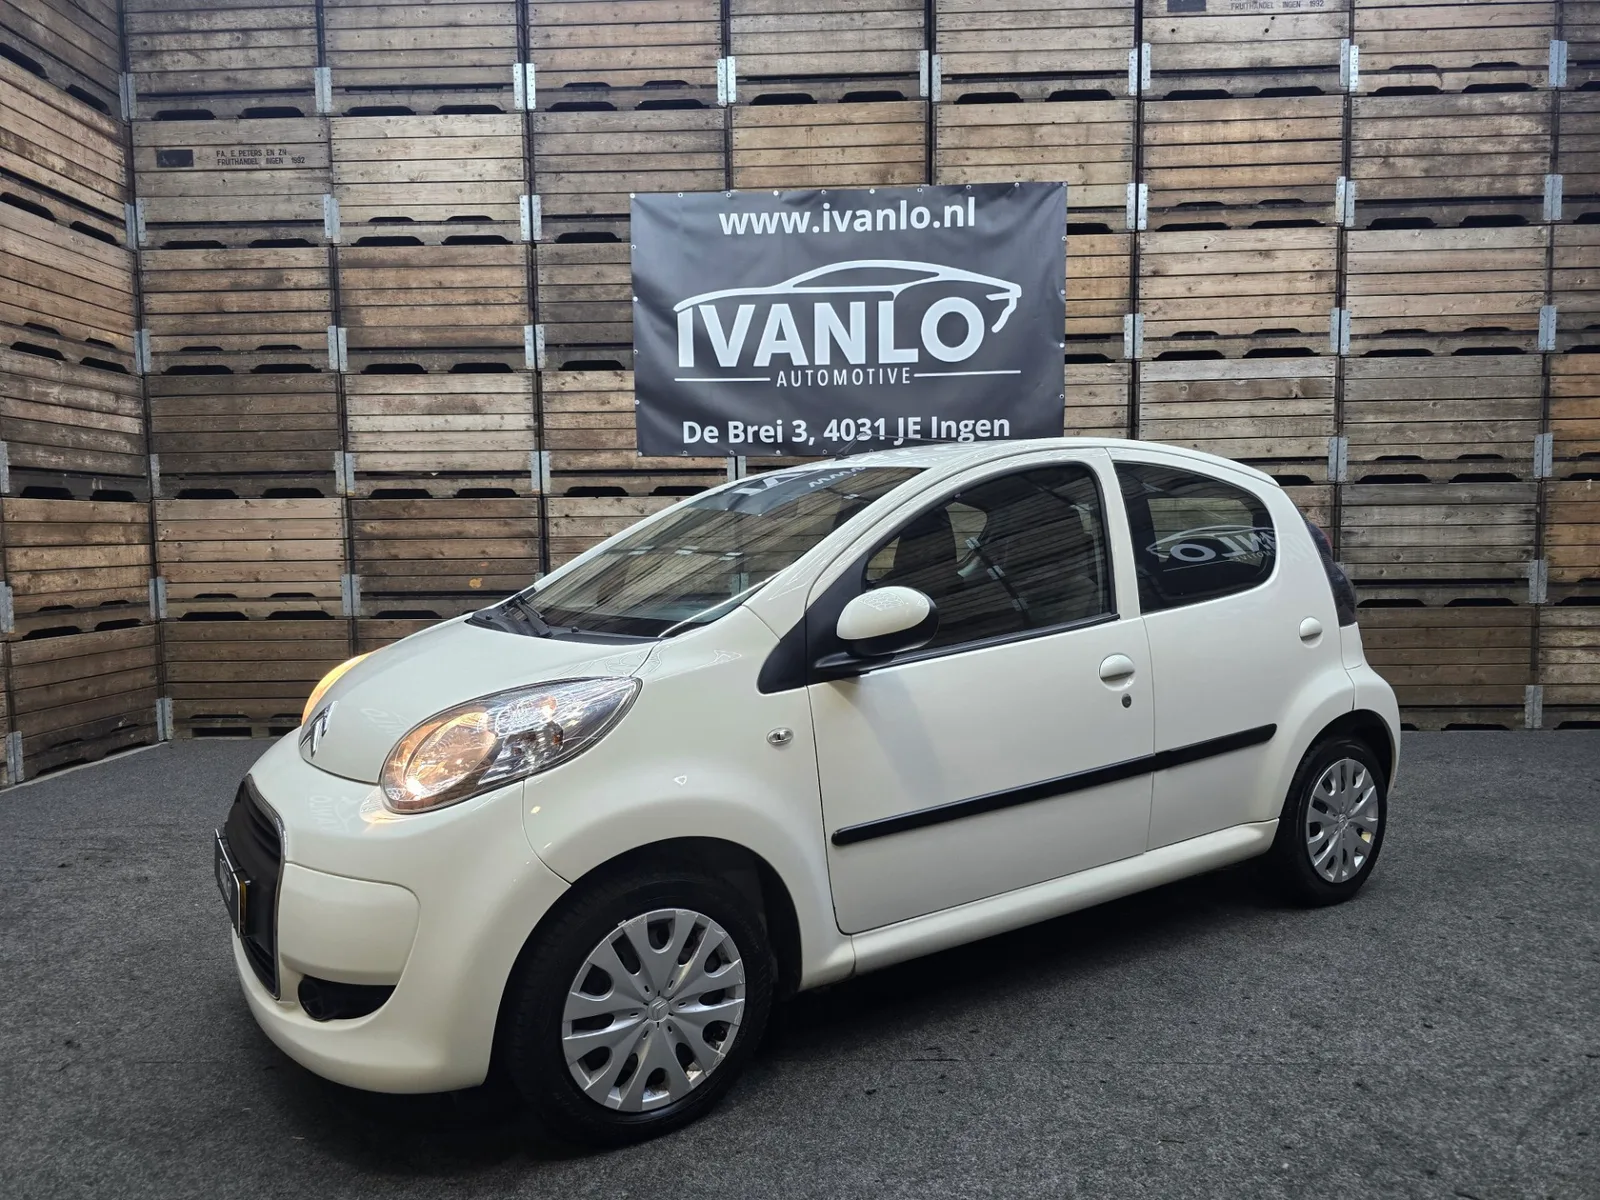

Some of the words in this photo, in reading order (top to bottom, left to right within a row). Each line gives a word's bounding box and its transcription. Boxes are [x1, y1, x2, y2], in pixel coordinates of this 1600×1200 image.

[217, 157, 258, 166] FRUITHANDEL
[718, 196, 976, 236] www.ivanlo.nl
[677, 296, 985, 368] IVANLO
[776, 367, 911, 388] AUTOMOTIVE
[682, 420, 719, 444] De
[728, 419, 783, 444] Brei
[791, 420, 814, 446] 3,
[823, 417, 886, 442] 4031
[893, 416, 922, 446] JE
[931, 415, 1010, 443] Ingen
